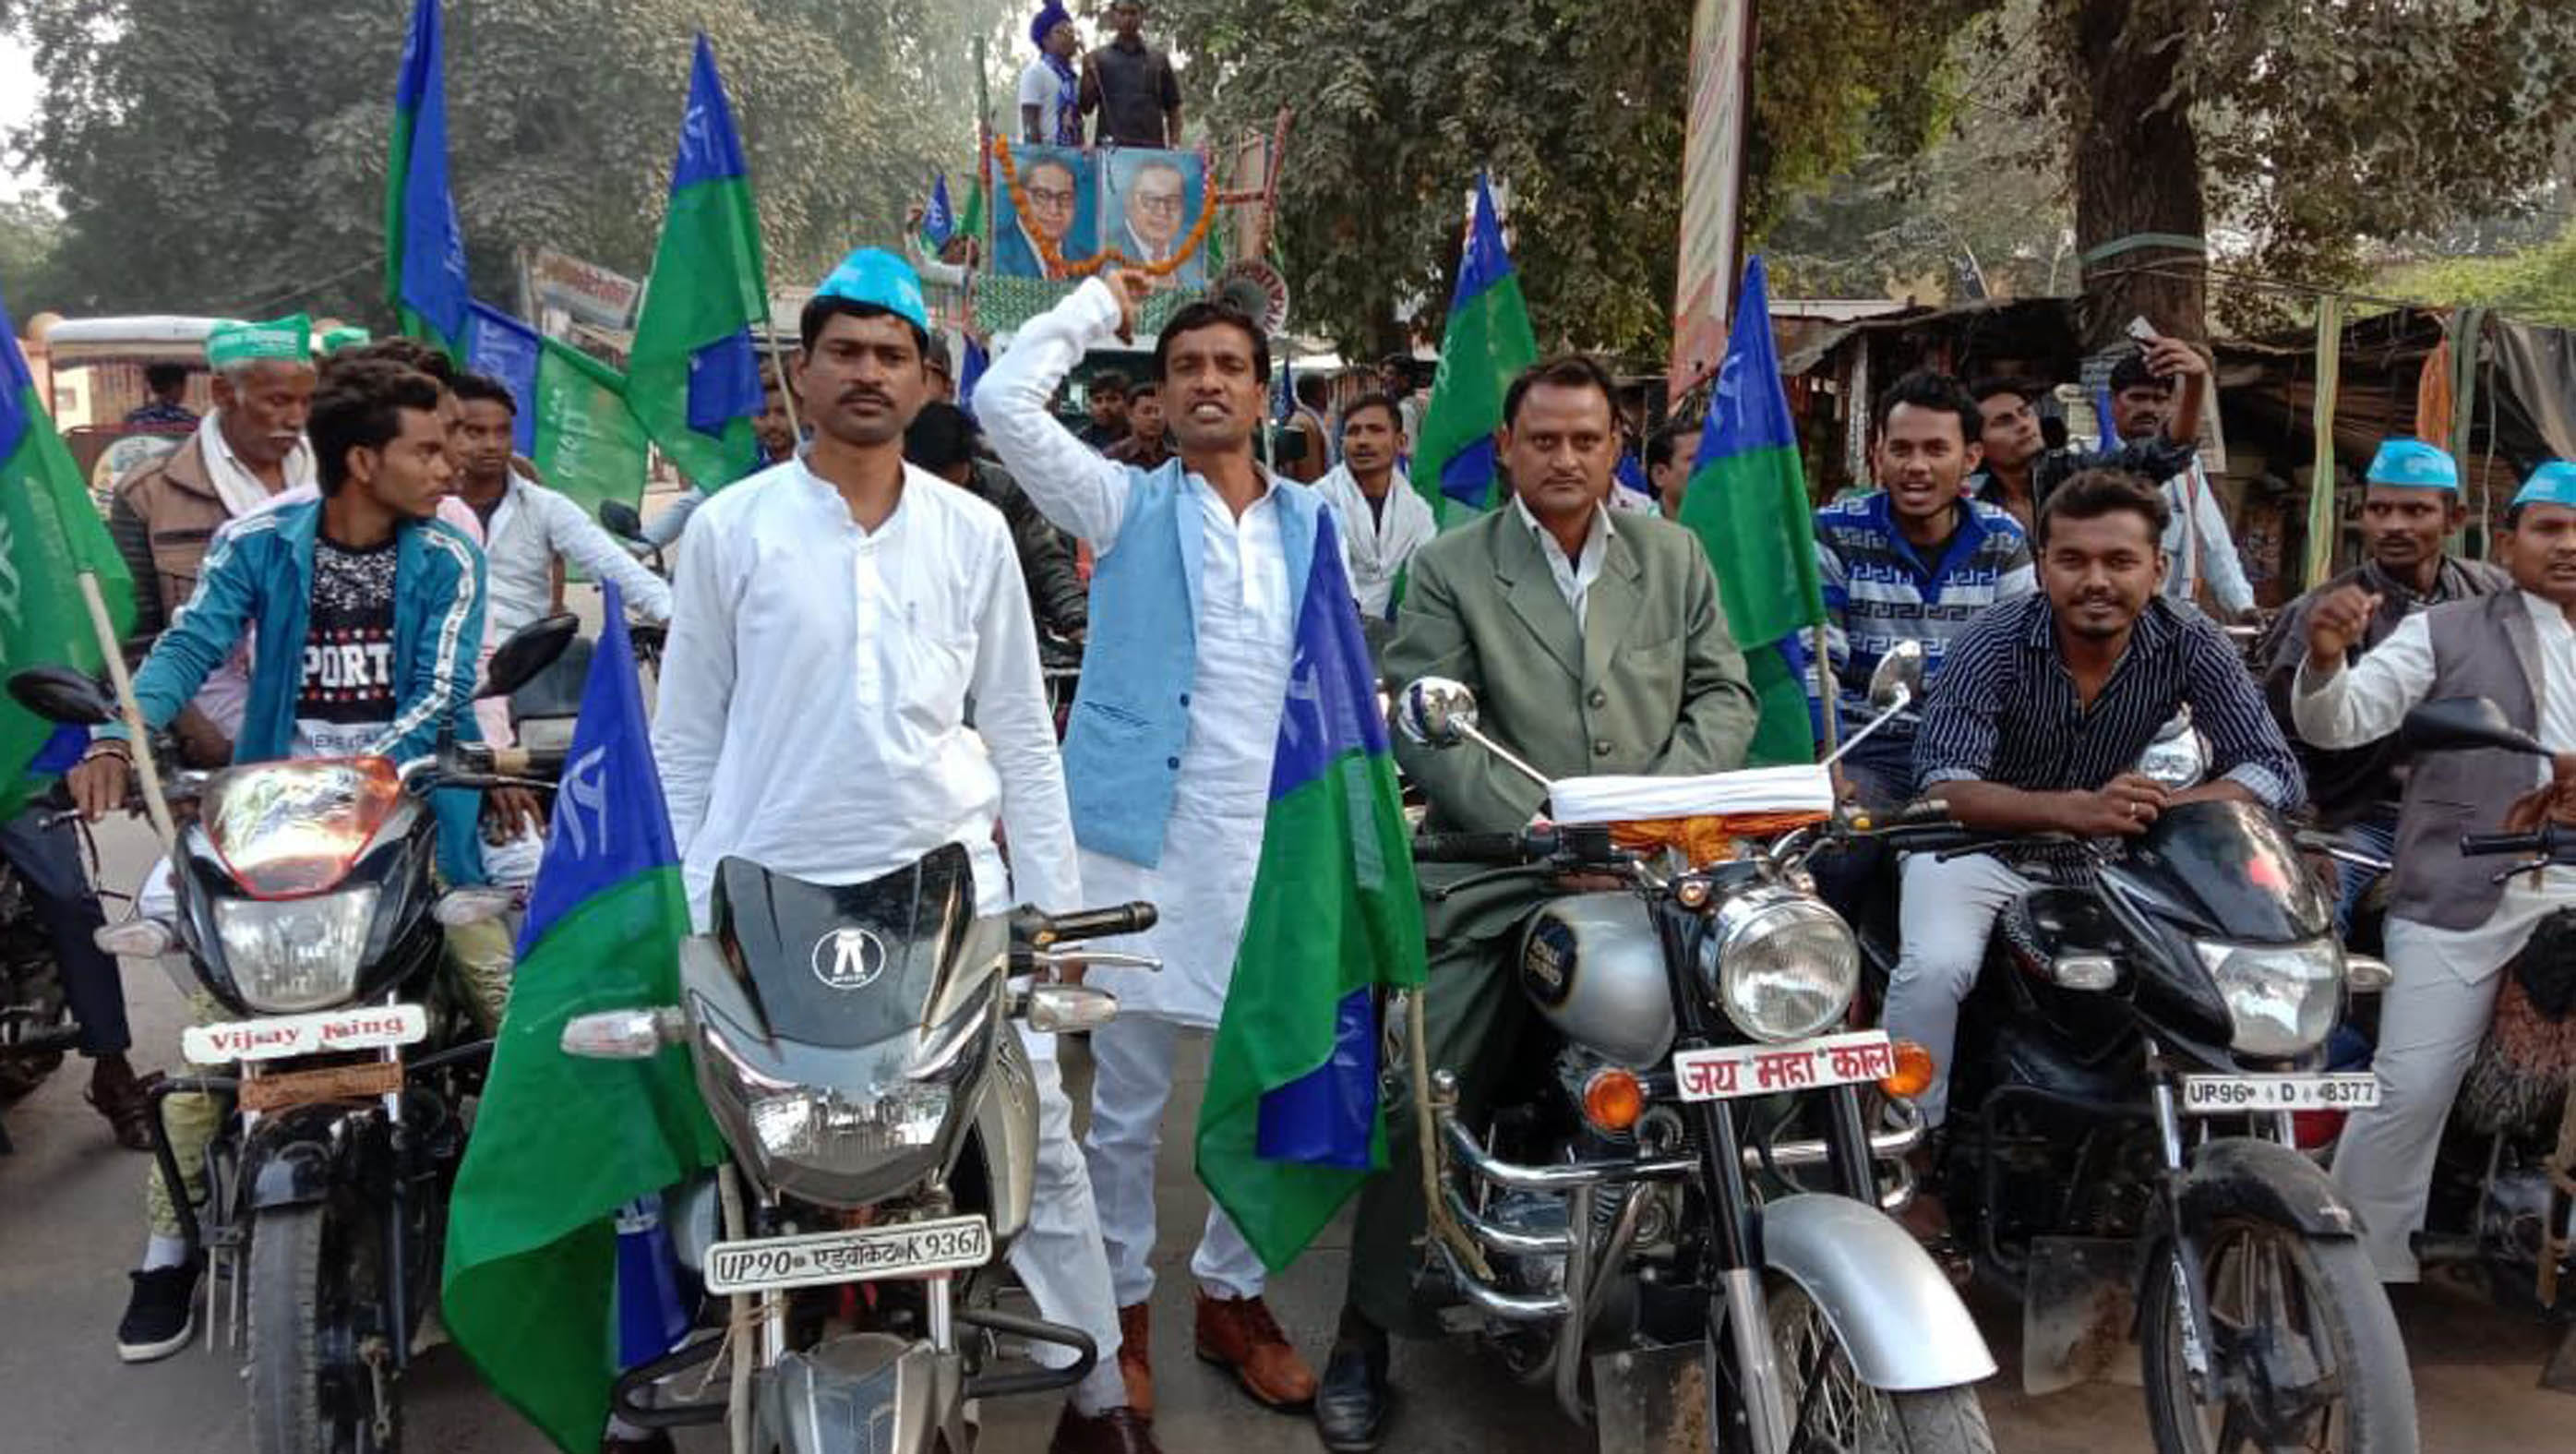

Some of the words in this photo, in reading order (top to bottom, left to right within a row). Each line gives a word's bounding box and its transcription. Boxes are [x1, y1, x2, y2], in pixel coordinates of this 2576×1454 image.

[302, 643, 397, 687] PORT
[1682, 1061, 1741, 1096] जय
[1829, 1042, 1891, 1080] काल
[2190, 1083, 2247, 1103] UP96
[2281, 1083, 2294, 1101] D
[719, 1248, 792, 1280] UP90
